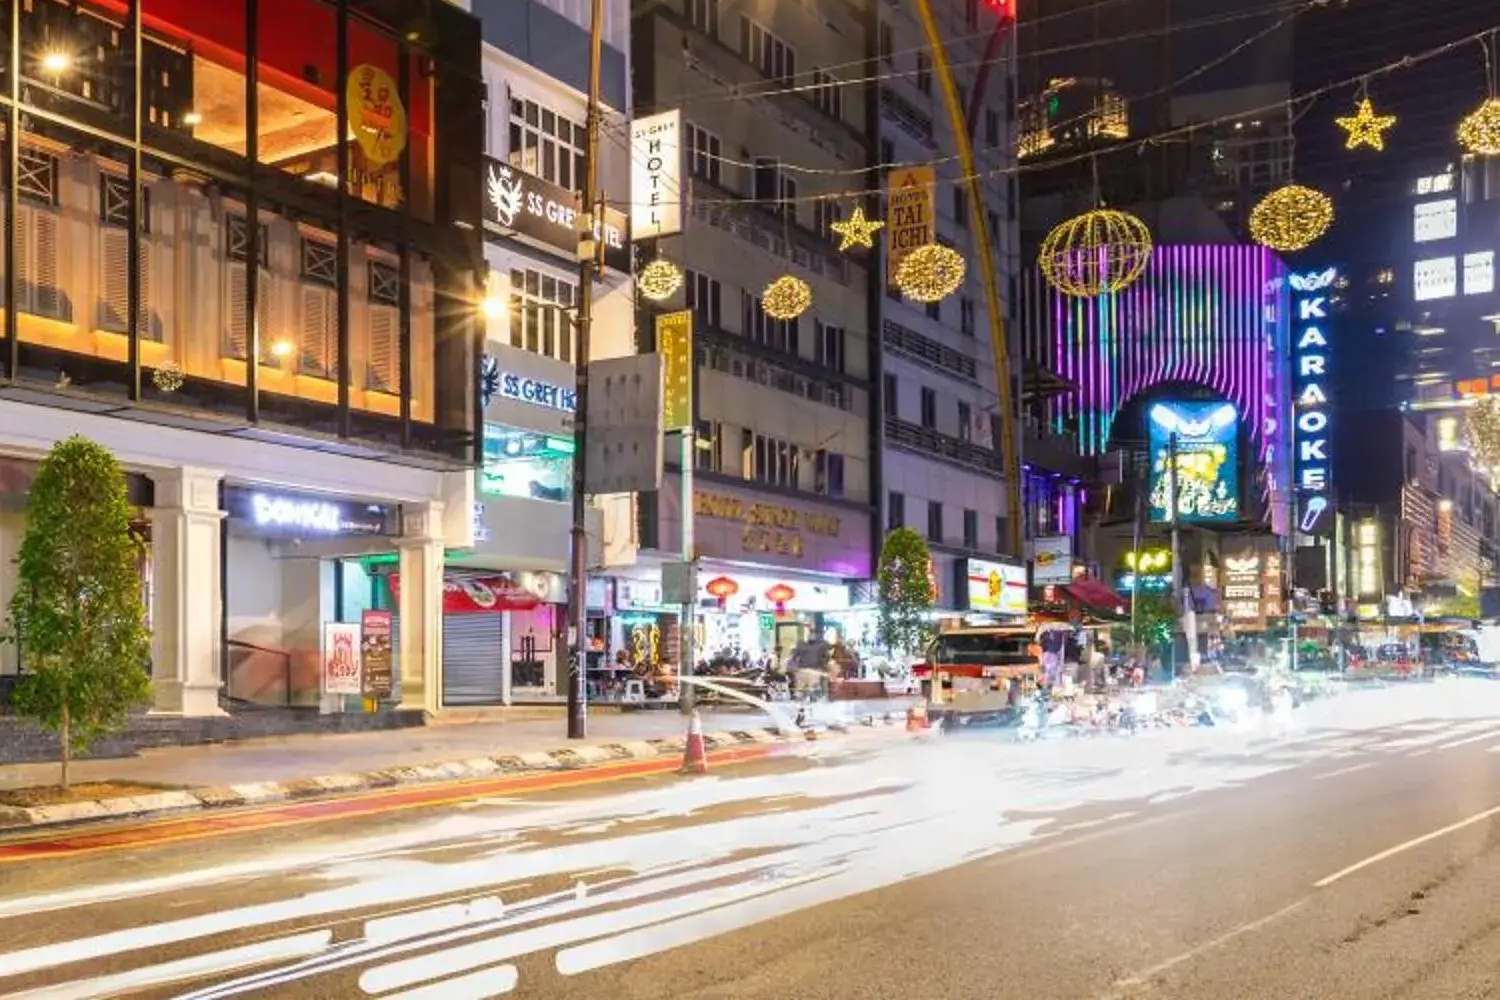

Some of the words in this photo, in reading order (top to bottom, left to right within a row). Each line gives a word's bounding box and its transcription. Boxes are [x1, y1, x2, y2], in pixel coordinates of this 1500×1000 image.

[527, 191, 544, 217] SS
[546, 200, 578, 230] GRE
[647, 138, 663, 226] HOTEL
[504, 373, 519, 397] SS
[1299, 299, 1327, 490] KARAOKE
